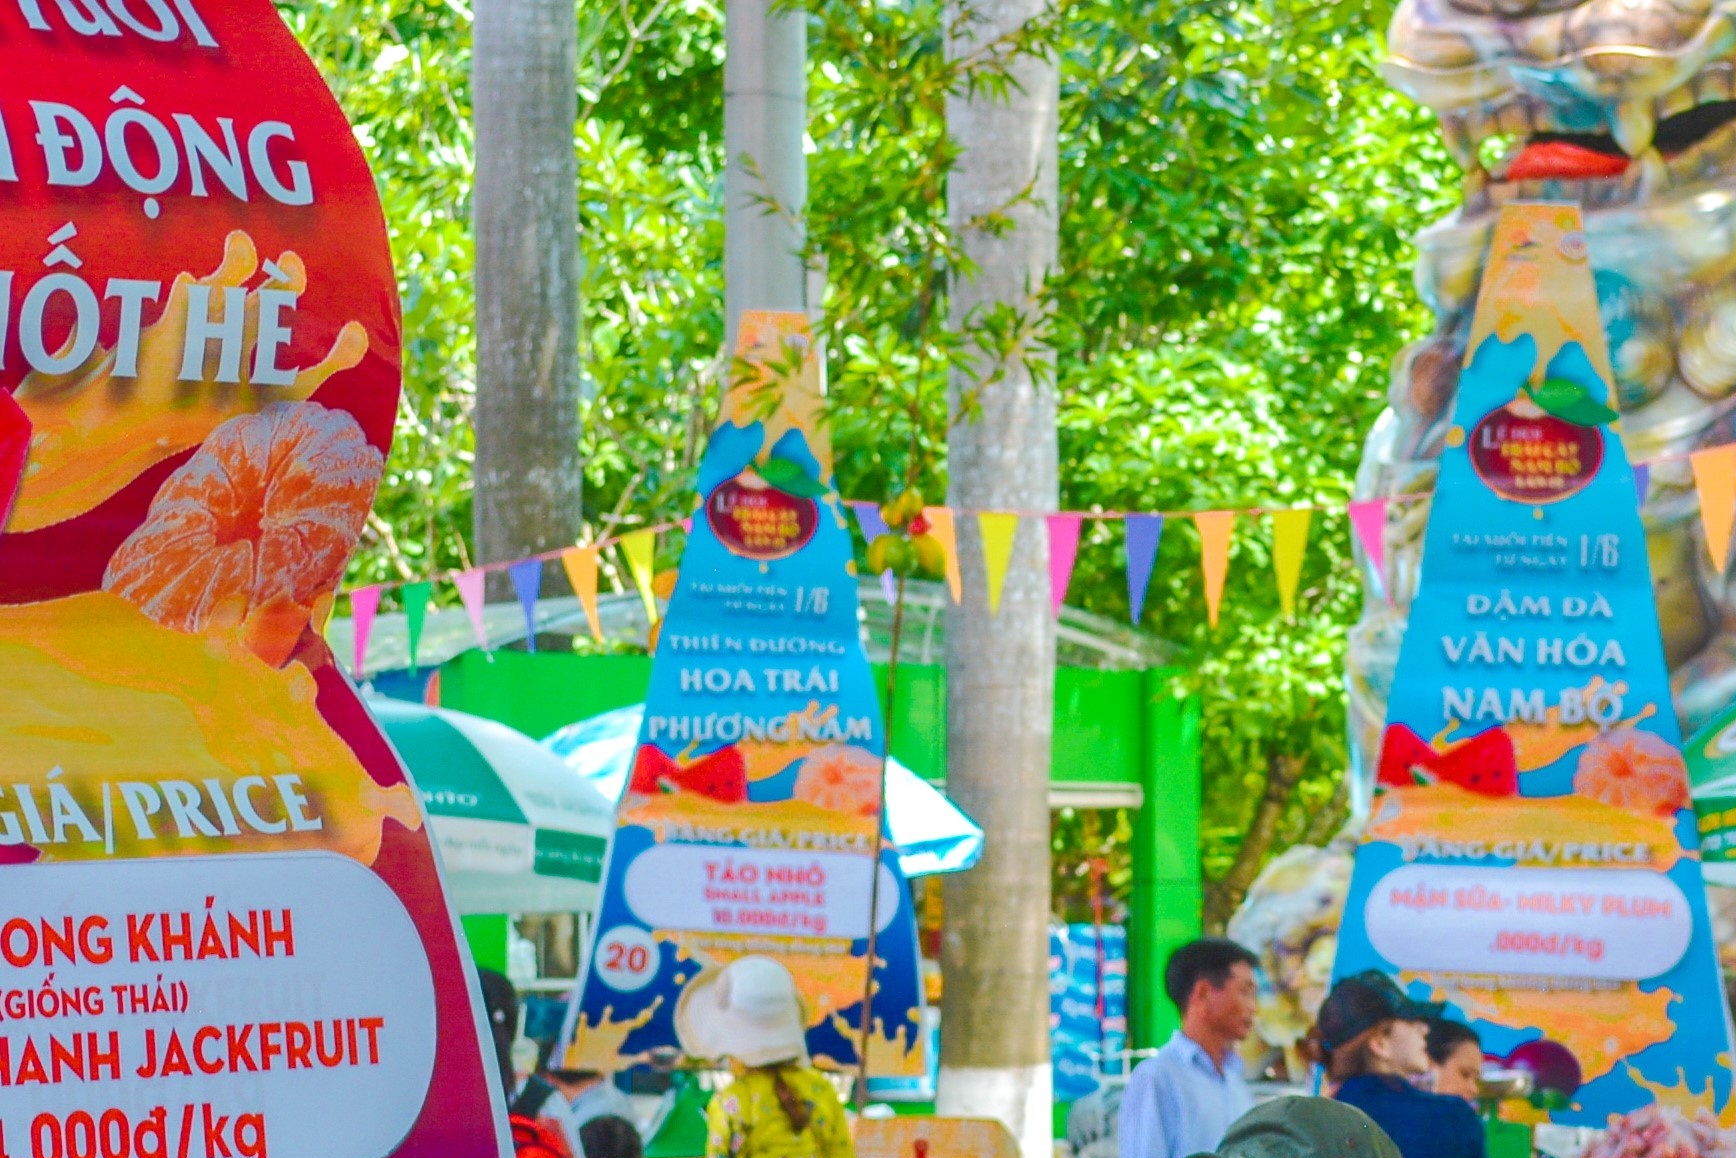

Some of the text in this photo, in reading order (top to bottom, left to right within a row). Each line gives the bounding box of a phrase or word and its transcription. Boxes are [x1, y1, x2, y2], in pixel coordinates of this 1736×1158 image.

[28, 84, 314, 219] ĐỘNG
[0, 221, 302, 386] ỐT HÈ
[1580, 532, 1620, 568] 1/6
[680, 664, 840, 692] HOA TRÁI
[649, 711, 789, 741] PHƯƠNG
[1441, 685, 1547, 726] NAM
[127, 896, 295, 964] KHÁNH
[606, 943, 649, 973] 20
[111, 972, 190, 1015] THÁI)
[135, 1016, 386, 1080] JACKFRUIT
